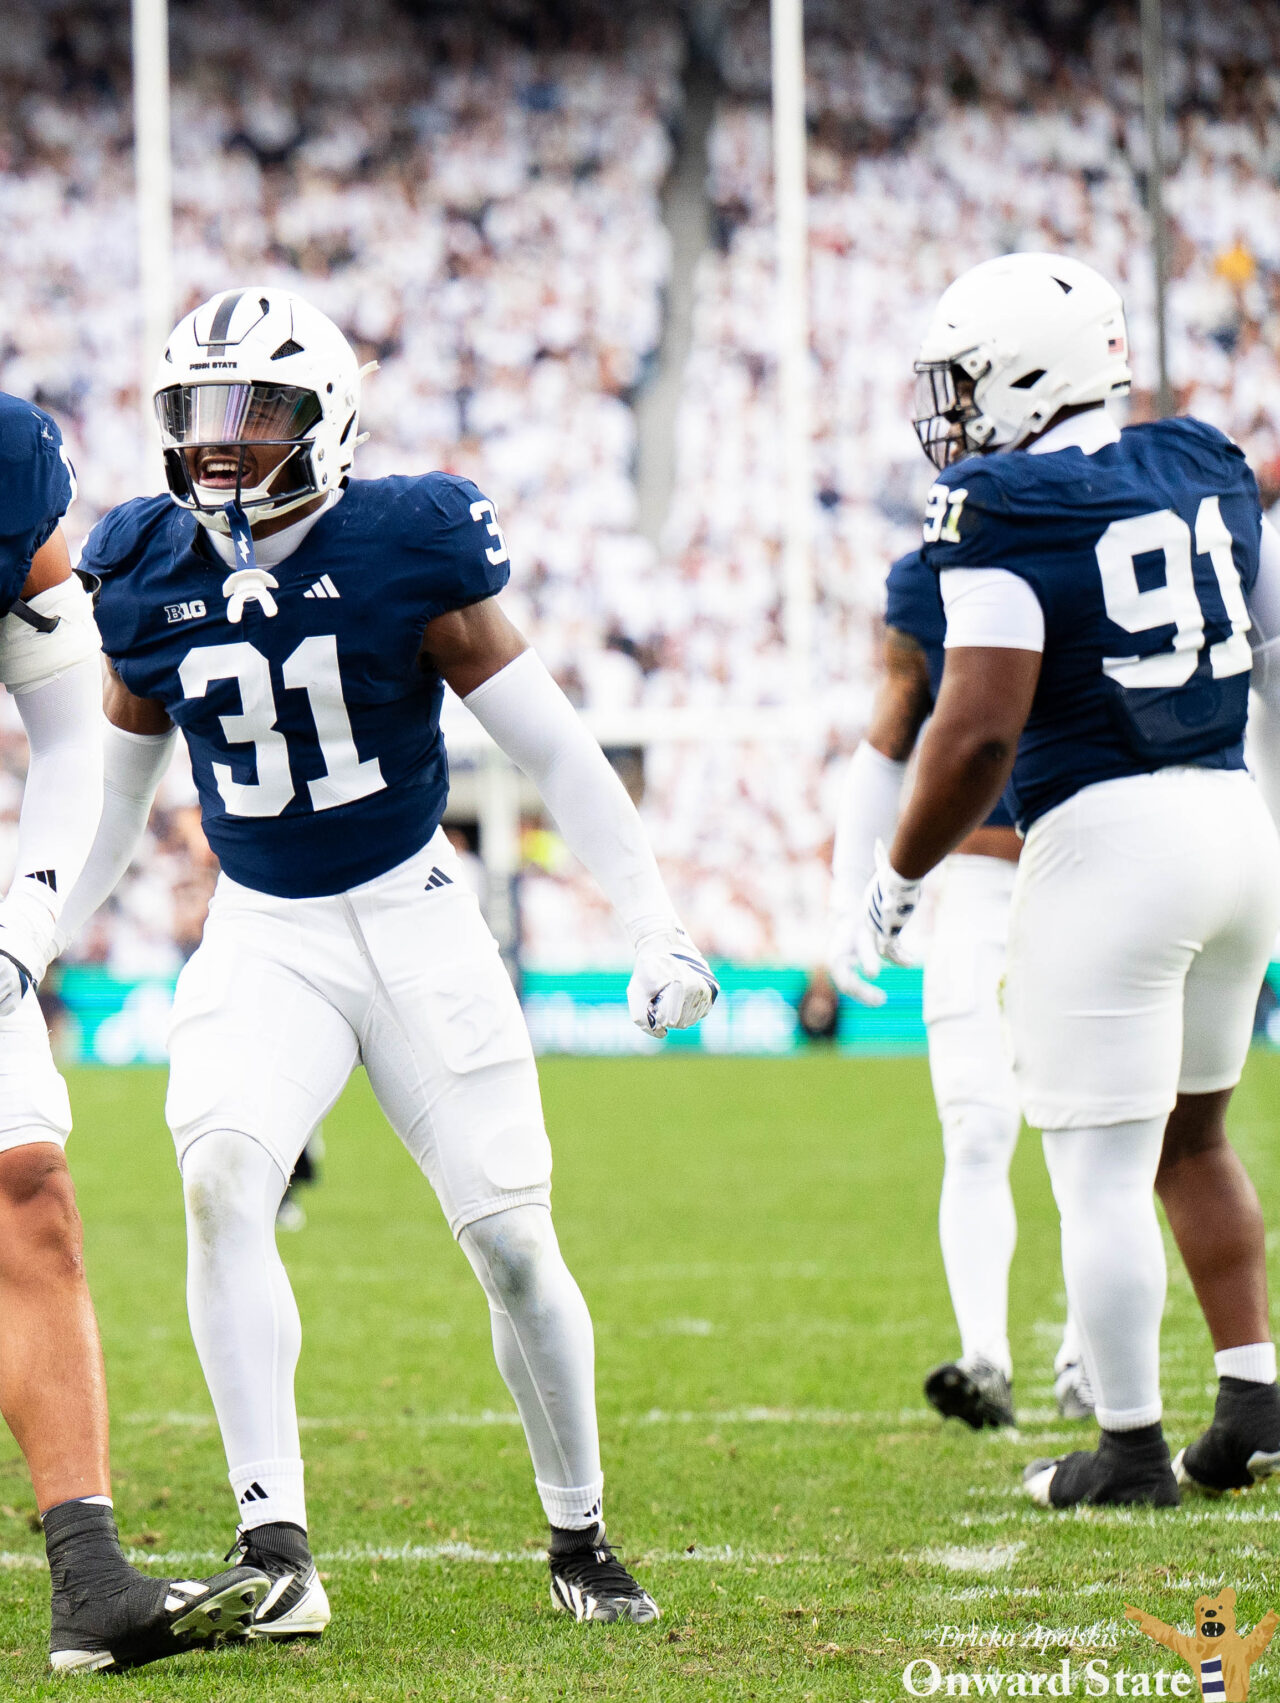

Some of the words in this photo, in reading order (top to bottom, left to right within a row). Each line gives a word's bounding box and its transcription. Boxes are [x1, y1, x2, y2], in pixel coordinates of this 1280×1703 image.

[189, 362, 210, 370] PENN
[212, 361, 237, 369] STATE
[923, 483, 968, 544] 91
[1095, 495, 1253, 688] 91
[177, 634, 389, 818] 31
